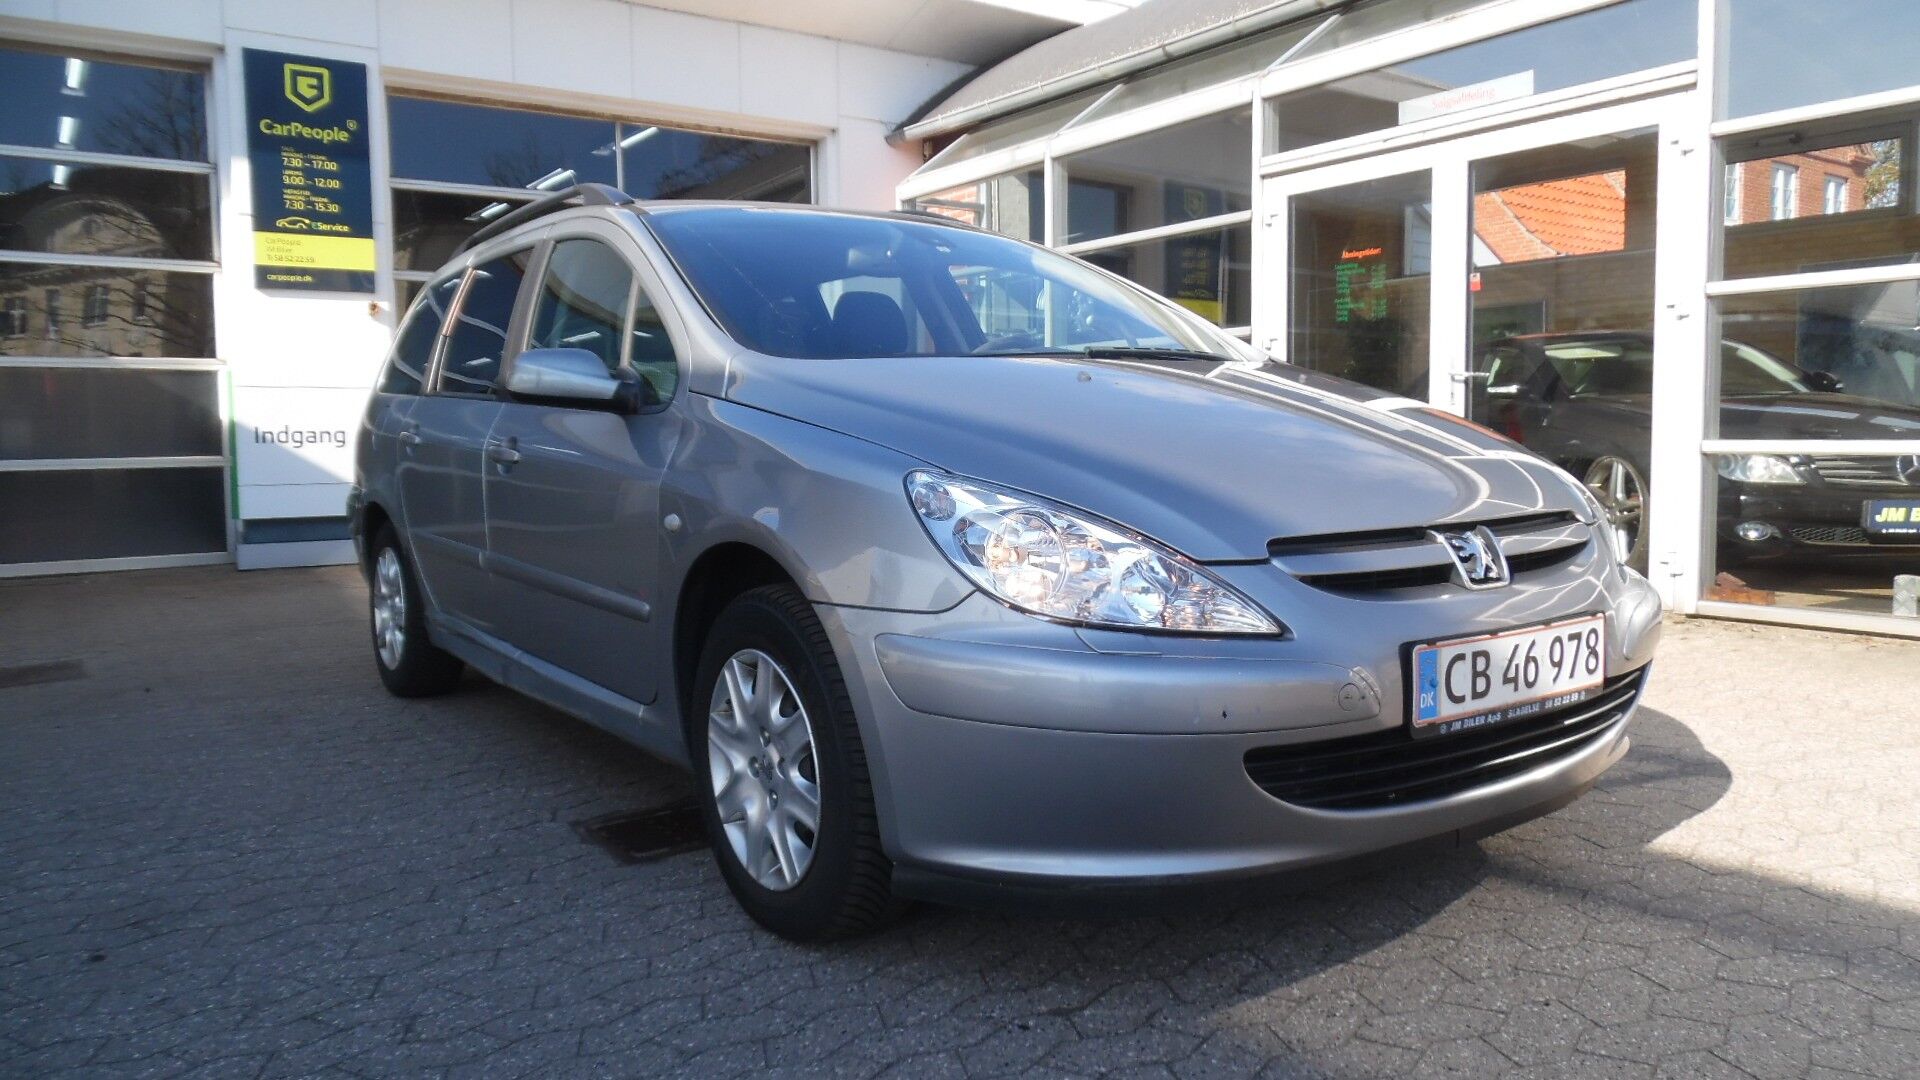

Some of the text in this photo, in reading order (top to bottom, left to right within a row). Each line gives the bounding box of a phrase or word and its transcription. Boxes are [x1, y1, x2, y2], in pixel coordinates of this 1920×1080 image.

[260, 119, 350, 144] CarPeople
[283, 157, 302, 168] 7.30
[312, 160, 337, 171] 17.00
[282, 175, 304, 186] 9.00
[314, 178, 340, 189] 12.00
[284, 200, 304, 210] 7.30
[314, 202, 339, 213] 15.30
[254, 424, 346, 449] Indgang
[1875, 507, 1907, 523] JM
[1444, 627, 1600, 704] CB 46 978
[1420, 691, 1434, 709] DK
